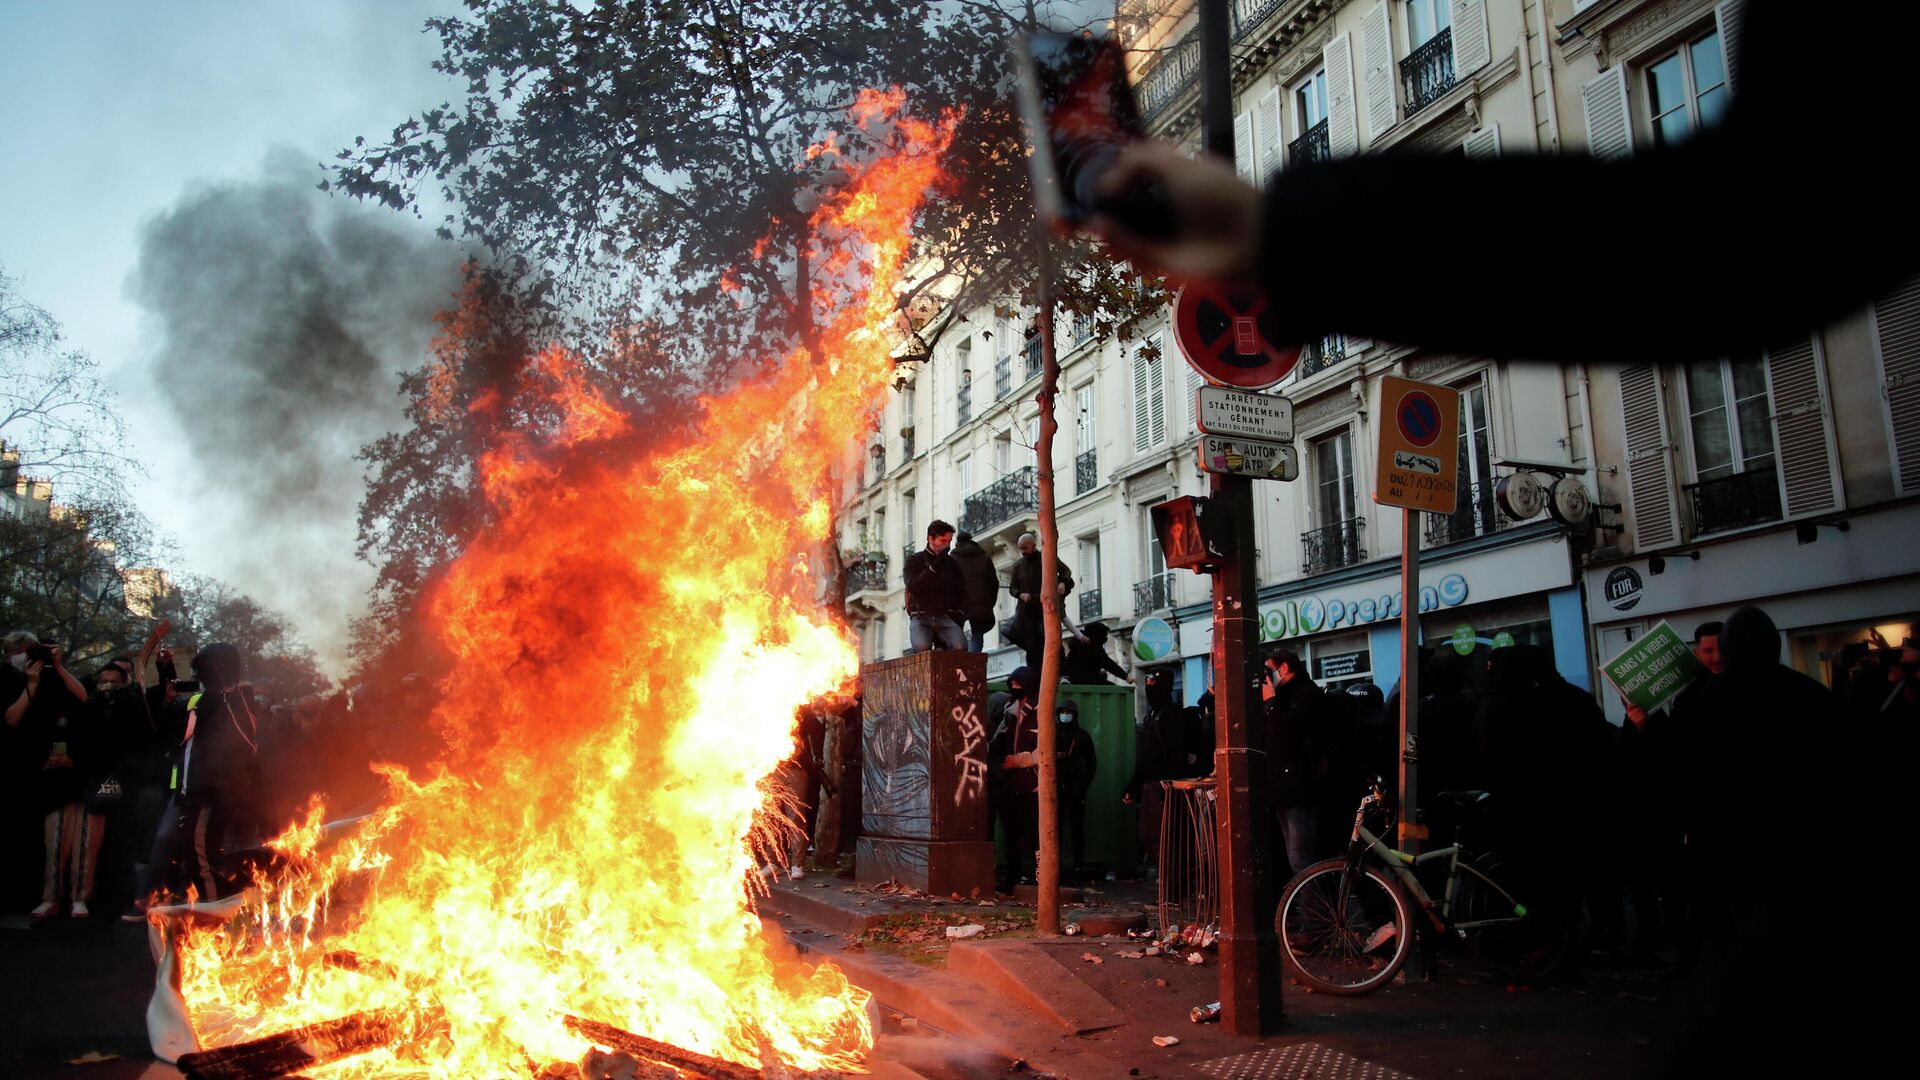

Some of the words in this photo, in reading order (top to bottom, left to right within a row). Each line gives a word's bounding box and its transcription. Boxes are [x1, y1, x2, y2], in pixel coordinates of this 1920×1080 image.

[1225, 393, 1254, 404] ARRÊT
[1257, 398, 1269, 406] OU
[1209, 401, 1285, 419] STATIONNEMENT
[1230, 413, 1265, 426] GÊNANT
[1273, 430, 1290, 438] ROUTE
[1390, 473, 1403, 484] DU
[1389, 487, 1403, 498] AU
[1614, 657, 1638, 679] SANS
[1635, 651, 1648, 663] LA
[1620, 672, 1652, 695] MICHEL
[1647, 652, 1677, 675] SERAIT
[1672, 643, 1687, 657] EN
[1647, 671, 1681, 697] PRISON
